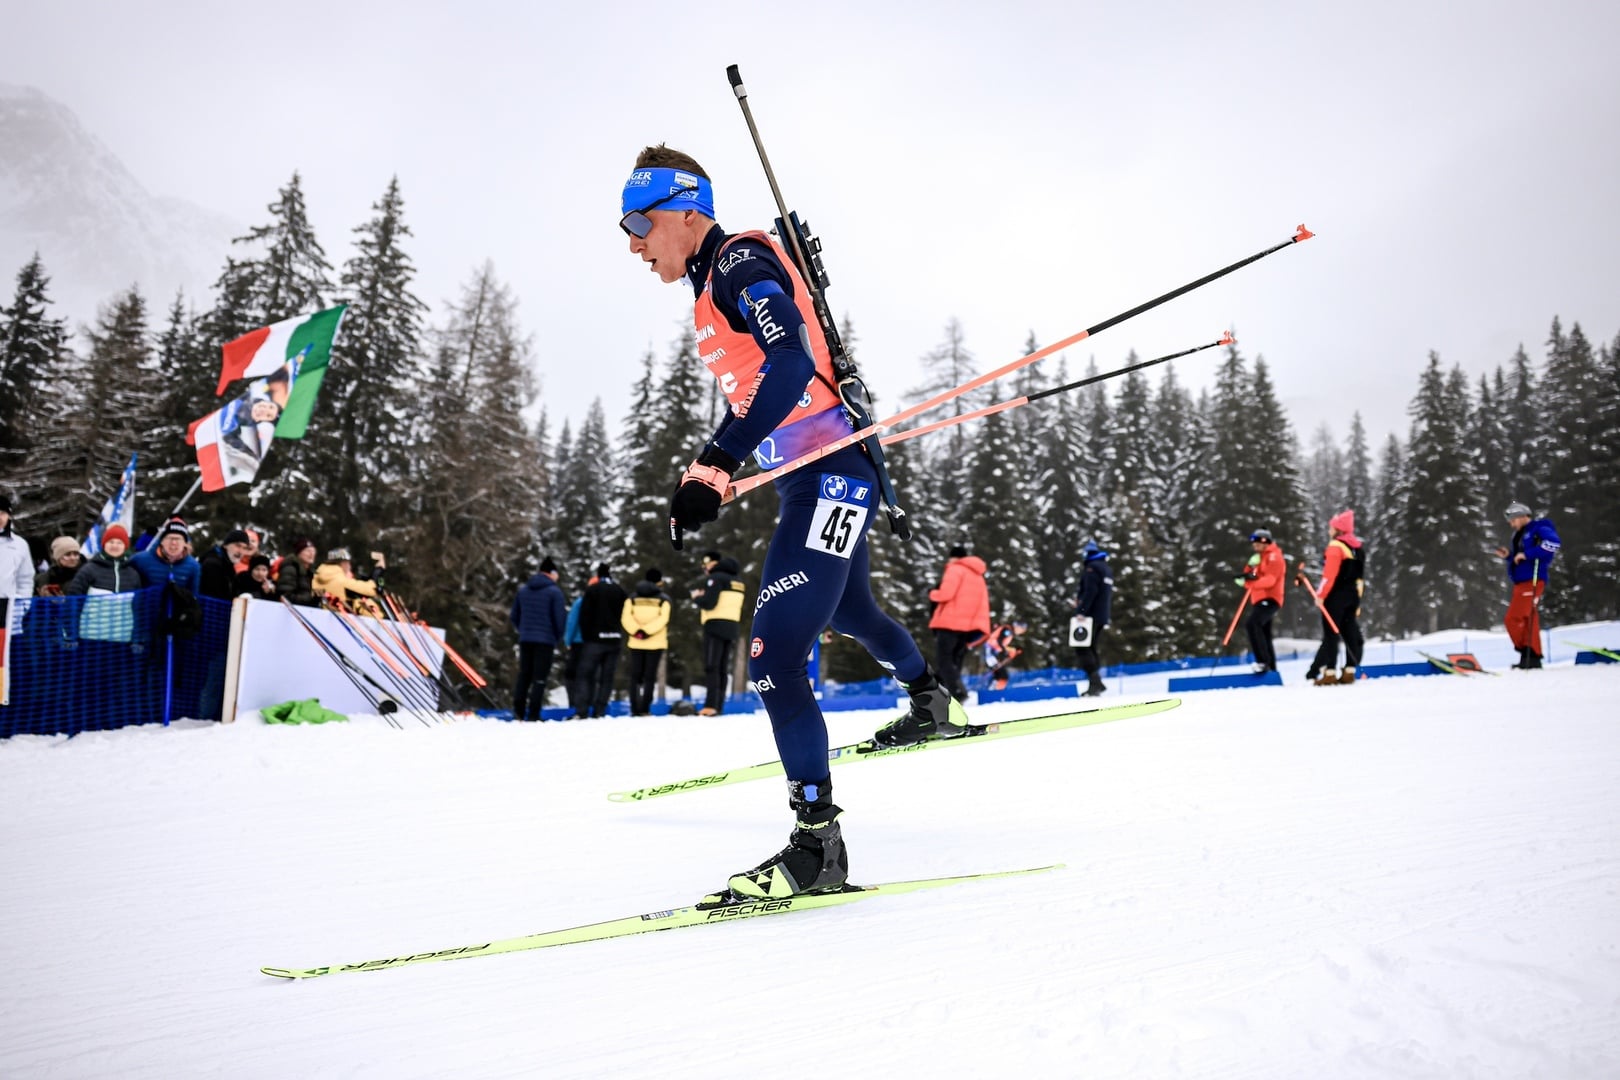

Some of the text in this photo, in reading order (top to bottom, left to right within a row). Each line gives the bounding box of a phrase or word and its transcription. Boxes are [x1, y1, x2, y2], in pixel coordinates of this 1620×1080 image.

[717, 248, 751, 274] EA7
[755, 297, 786, 345] Audi
[819, 505, 858, 554] 45
[648, 772, 729, 797] FISCHER
[706, 900, 793, 920] FISCHER
[340, 943, 492, 971] FISCHER
